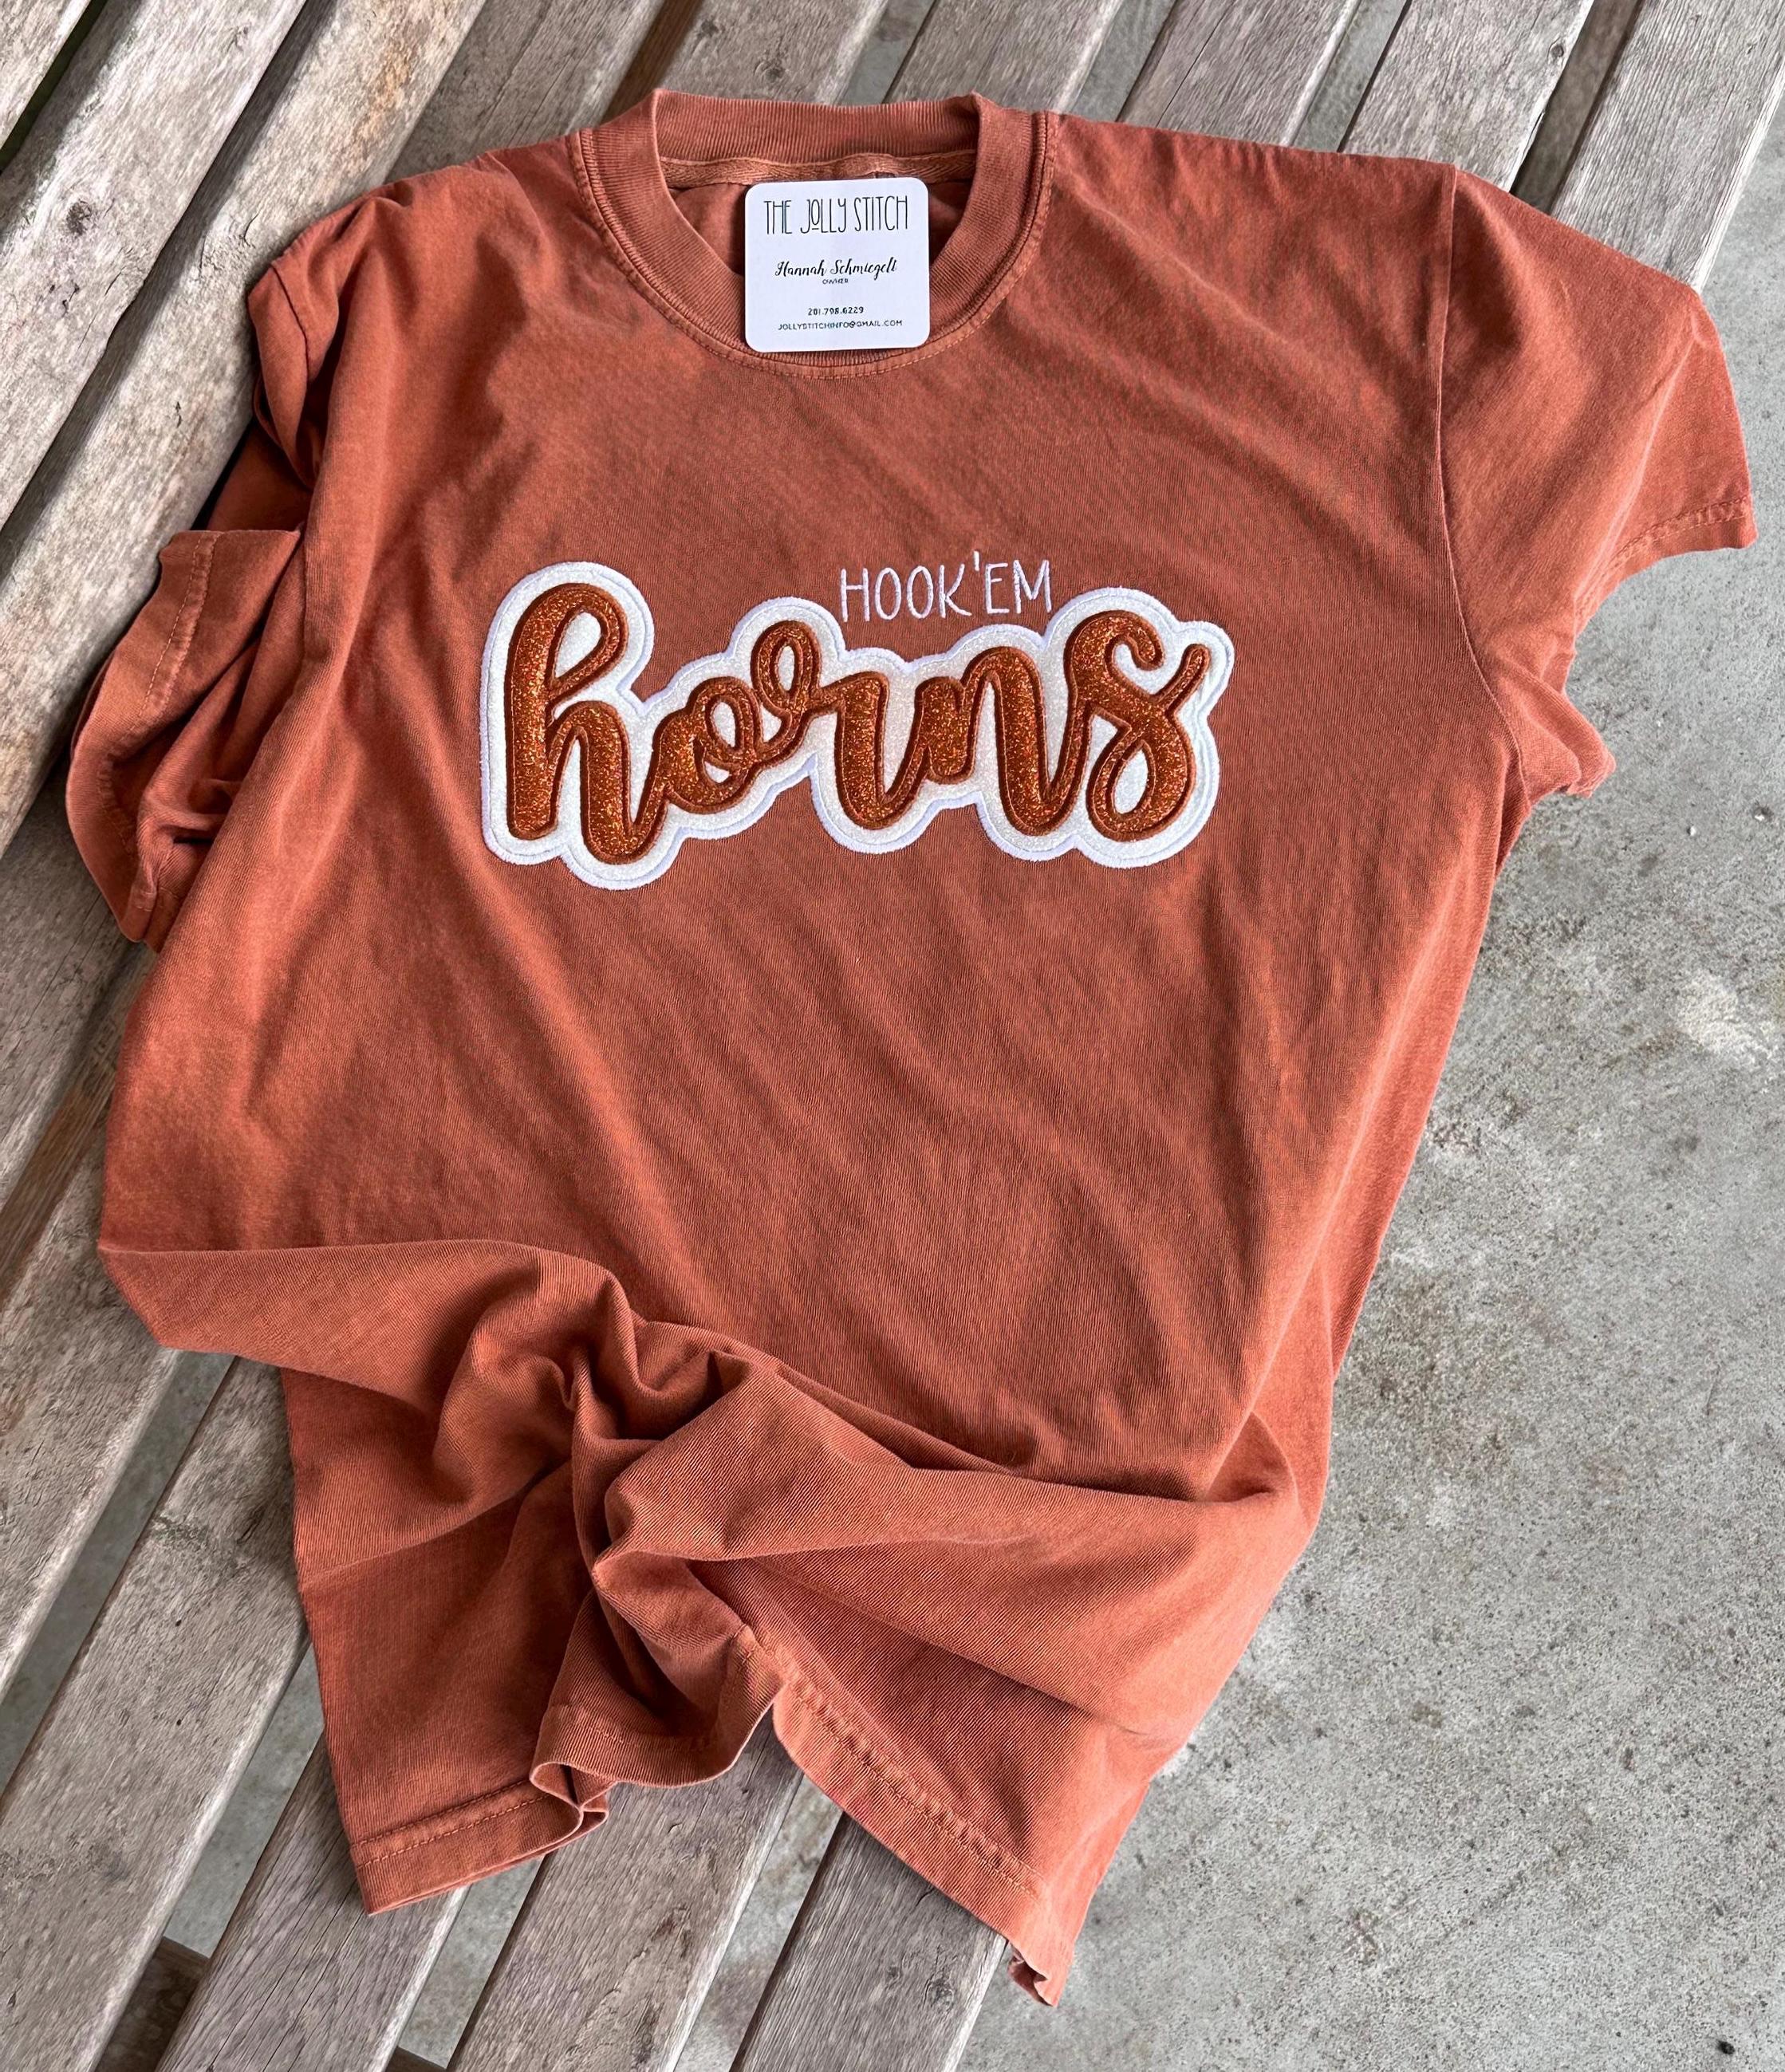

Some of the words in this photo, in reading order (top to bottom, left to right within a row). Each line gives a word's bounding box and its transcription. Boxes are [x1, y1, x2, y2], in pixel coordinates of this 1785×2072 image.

[763, 199, 793, 234] THE
[800, 198, 847, 234] JOLLY
[853, 195, 908, 232] STITCH
[774, 259, 827, 278] Hannah
[840, 550, 1052, 622] HOOK'EM
[504, 583, 1208, 865] horns
